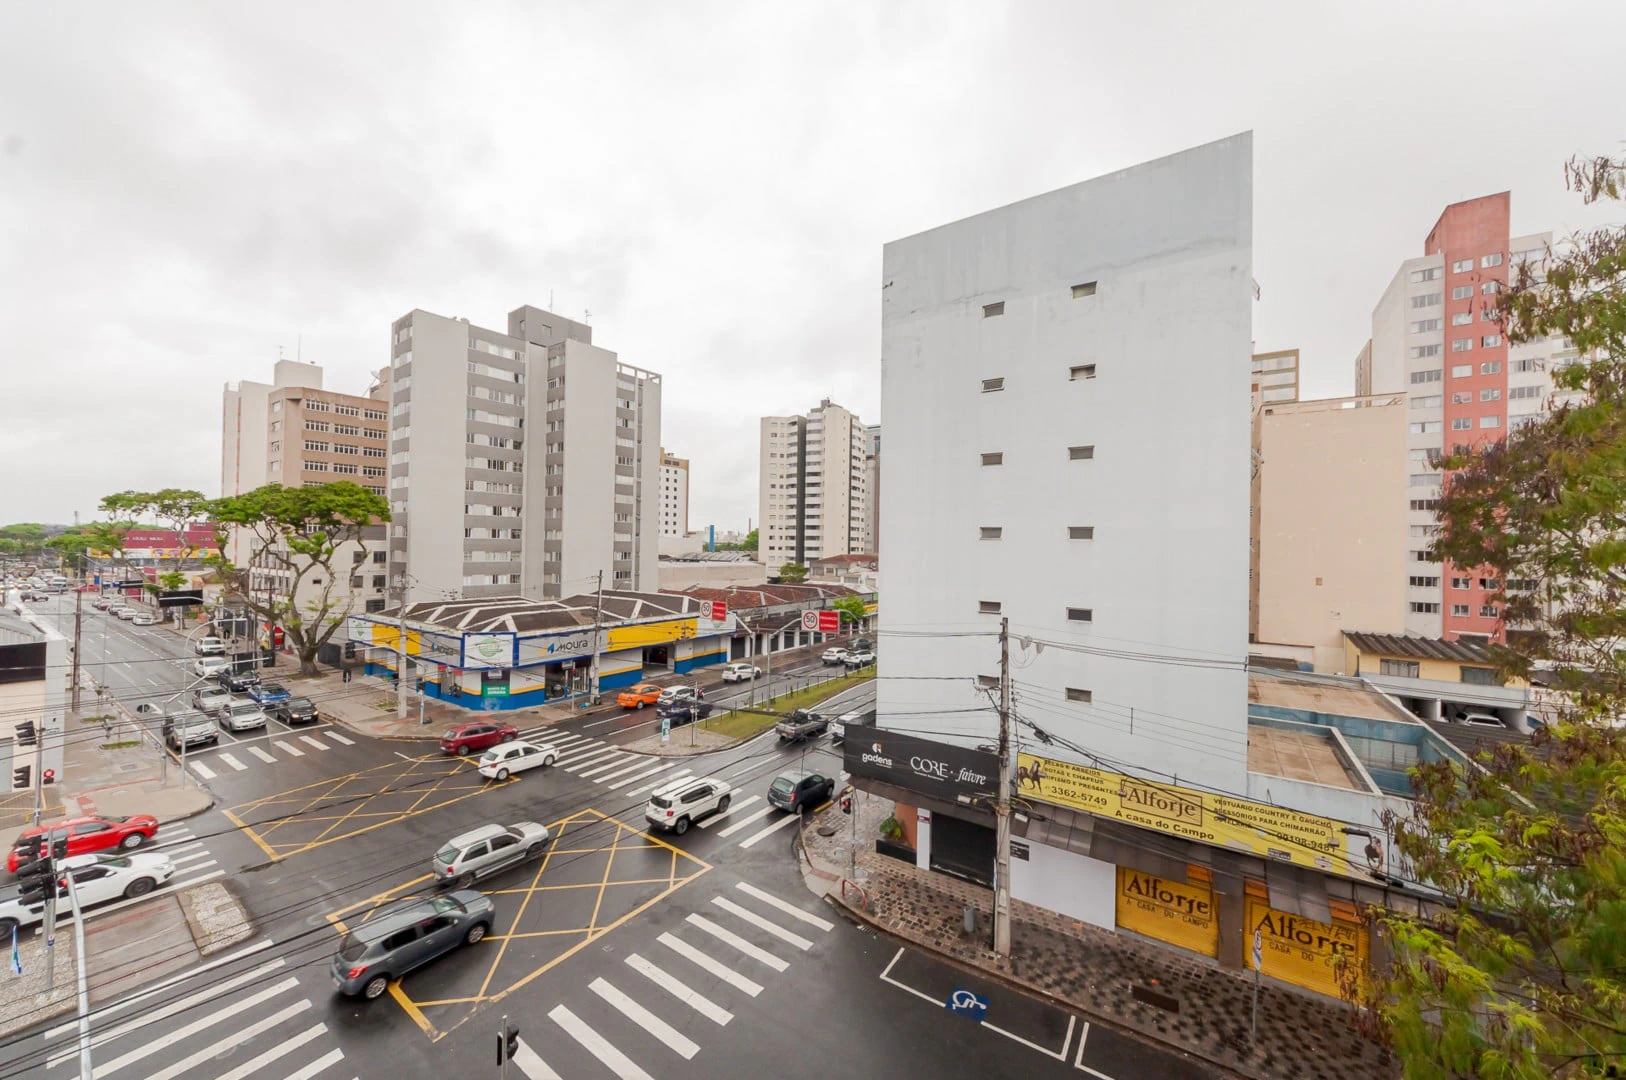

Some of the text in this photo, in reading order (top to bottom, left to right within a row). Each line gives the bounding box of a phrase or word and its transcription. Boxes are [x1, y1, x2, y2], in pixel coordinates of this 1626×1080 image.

[805, 615, 815, 624] 50
[910, 756, 949, 778] CORE
[1051, 786, 1107, 806] 3362-5749
[1127, 787, 1196, 817] Alforje
[1255, 807, 1290, 819] COUNTRY
[1259, 816, 1278, 826] PARA
[1115, 809, 1215, 840] A casa do Campo
[1127, 874, 1208, 914] Alforje
[1137, 901, 1156, 913] CASA
[1164, 908, 1175, 918] DO
[1183, 915, 1208, 929] CAMPO
[1269, 941, 1314, 962] CASA DO
